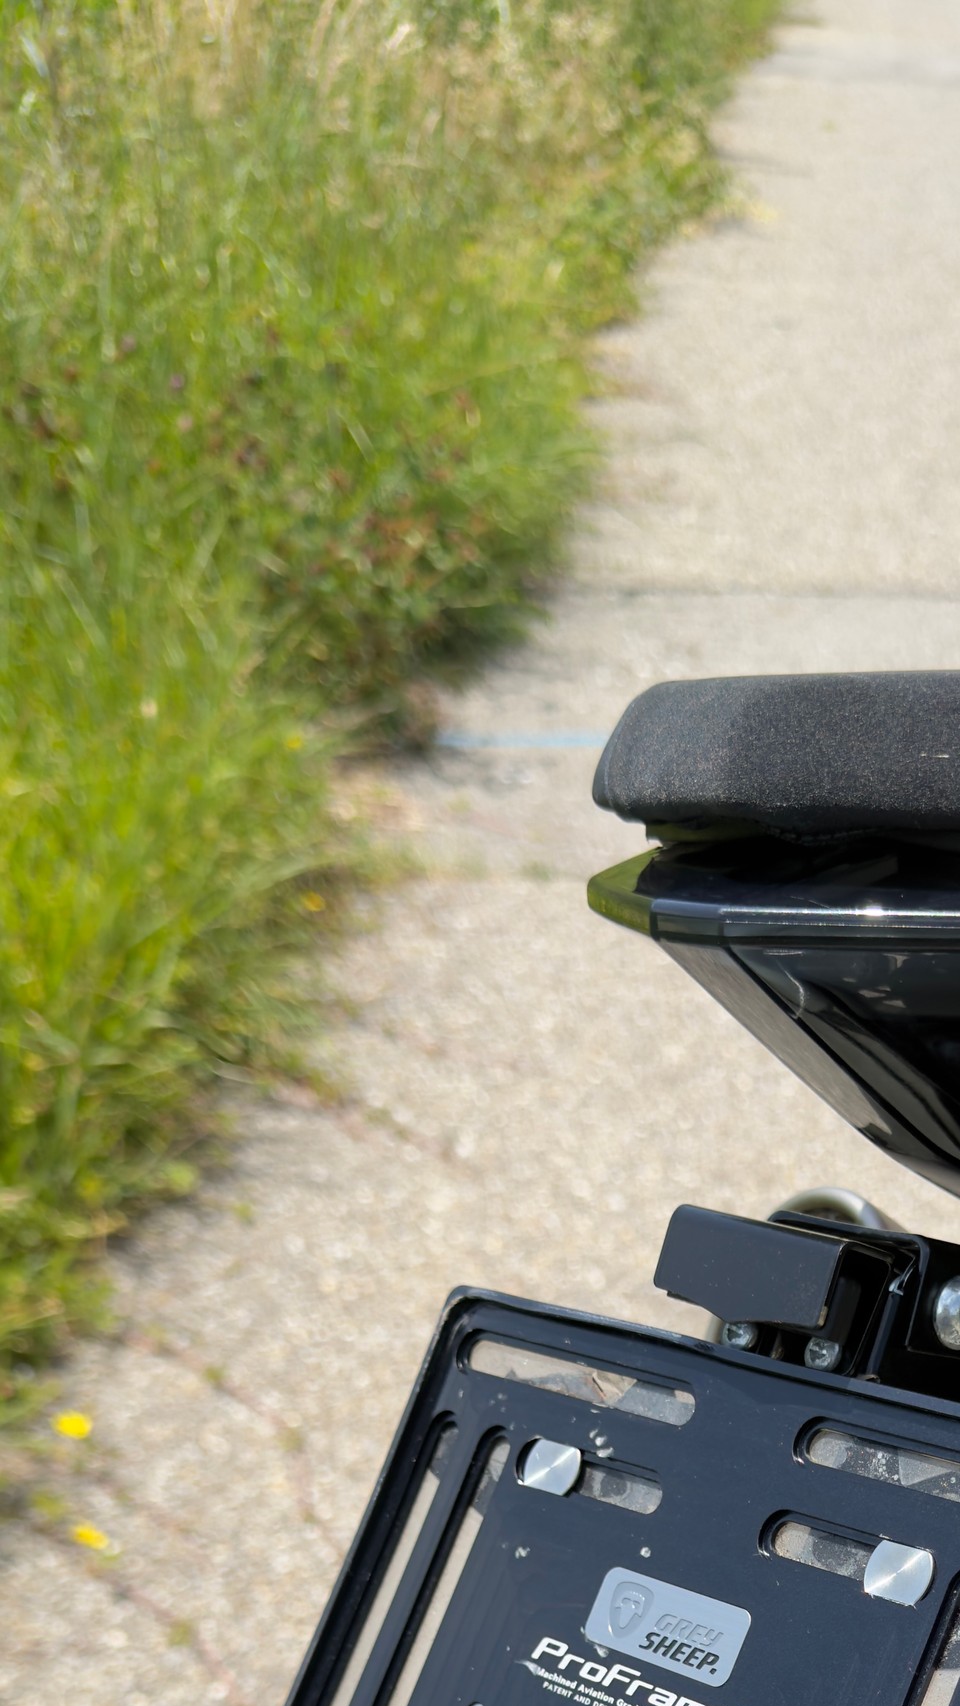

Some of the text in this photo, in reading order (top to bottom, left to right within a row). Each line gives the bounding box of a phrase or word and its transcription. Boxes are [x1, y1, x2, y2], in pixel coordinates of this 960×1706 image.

[654, 1613, 724, 1647] GREY
[537, 1667, 577, 1690] Machined
[577, 1684, 615, 1704] Aviation
[542, 1681, 573, 1698] PATENT
[573, 1694, 591, 1706] AND
